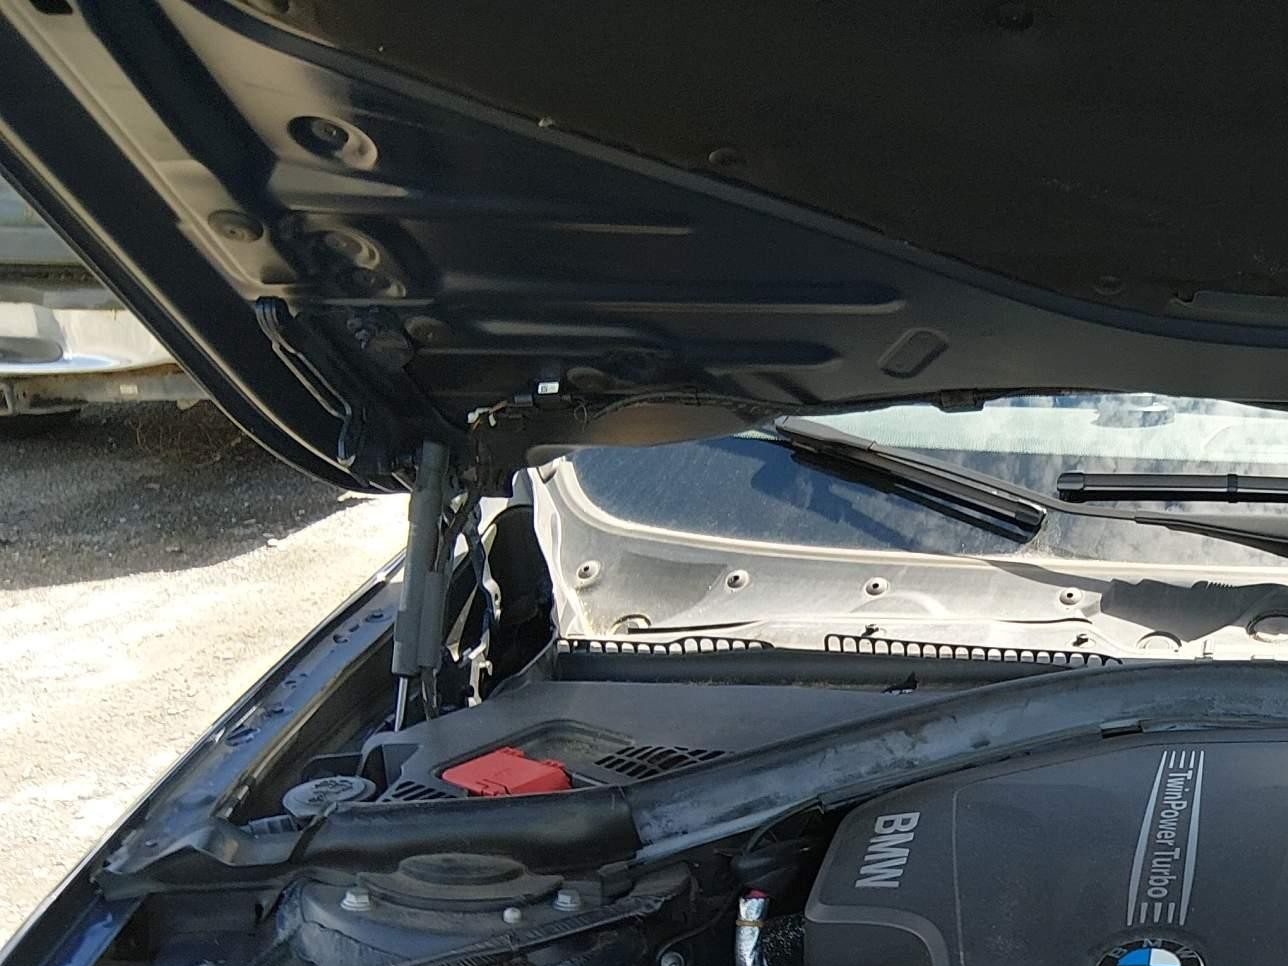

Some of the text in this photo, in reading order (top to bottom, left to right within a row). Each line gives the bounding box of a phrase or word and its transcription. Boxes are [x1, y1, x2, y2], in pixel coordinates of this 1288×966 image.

[854, 811, 921, 889] BMW
[1147, 770, 1193, 899] TwinPower Turbo
[1105, 938, 1198, 960] BMW
